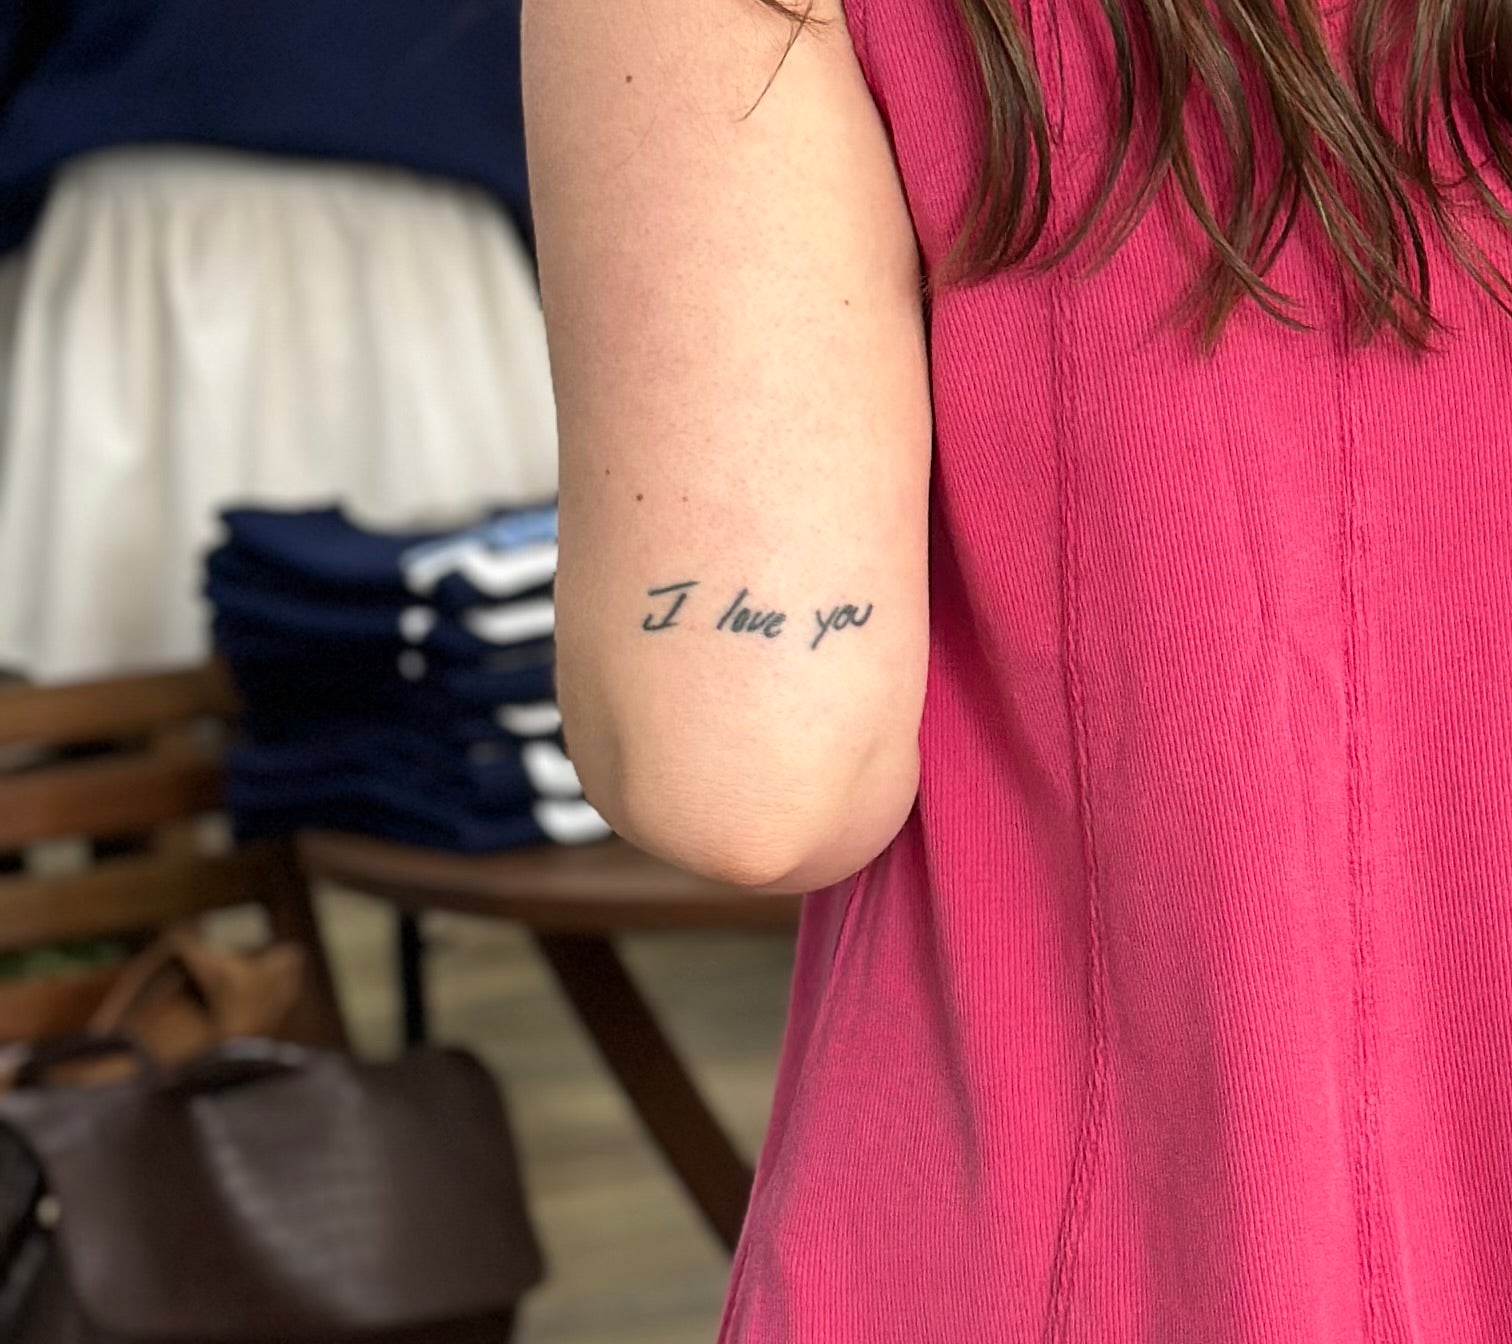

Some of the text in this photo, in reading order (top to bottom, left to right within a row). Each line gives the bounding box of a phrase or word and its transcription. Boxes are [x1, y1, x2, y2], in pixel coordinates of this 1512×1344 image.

[642, 581, 874, 650] I love you
